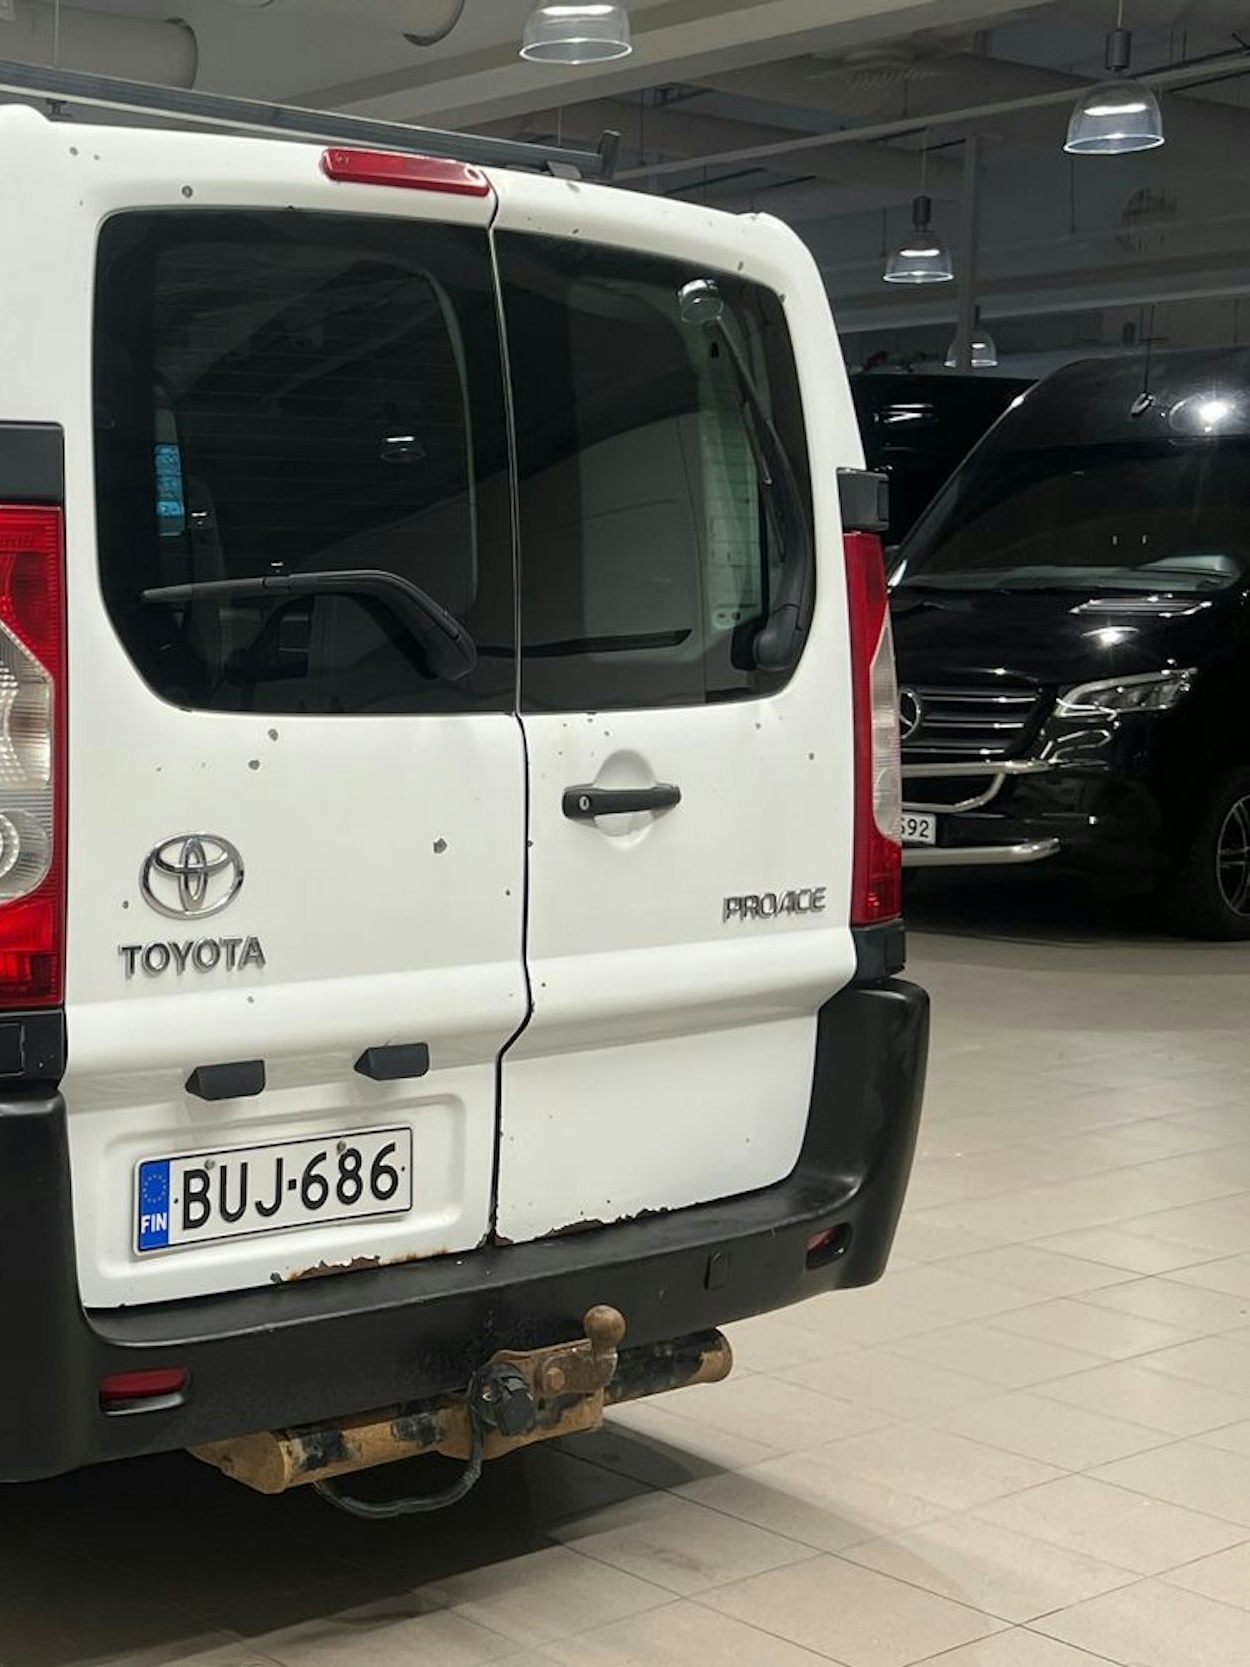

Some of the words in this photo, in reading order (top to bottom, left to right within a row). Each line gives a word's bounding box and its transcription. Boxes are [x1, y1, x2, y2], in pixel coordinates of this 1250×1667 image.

[723, 887, 826, 922] PROACE
[118, 936, 266, 980] TOYOTA
[182, 1142, 399, 1231] BUJ-686
[140, 1212, 168, 1235] FIN
